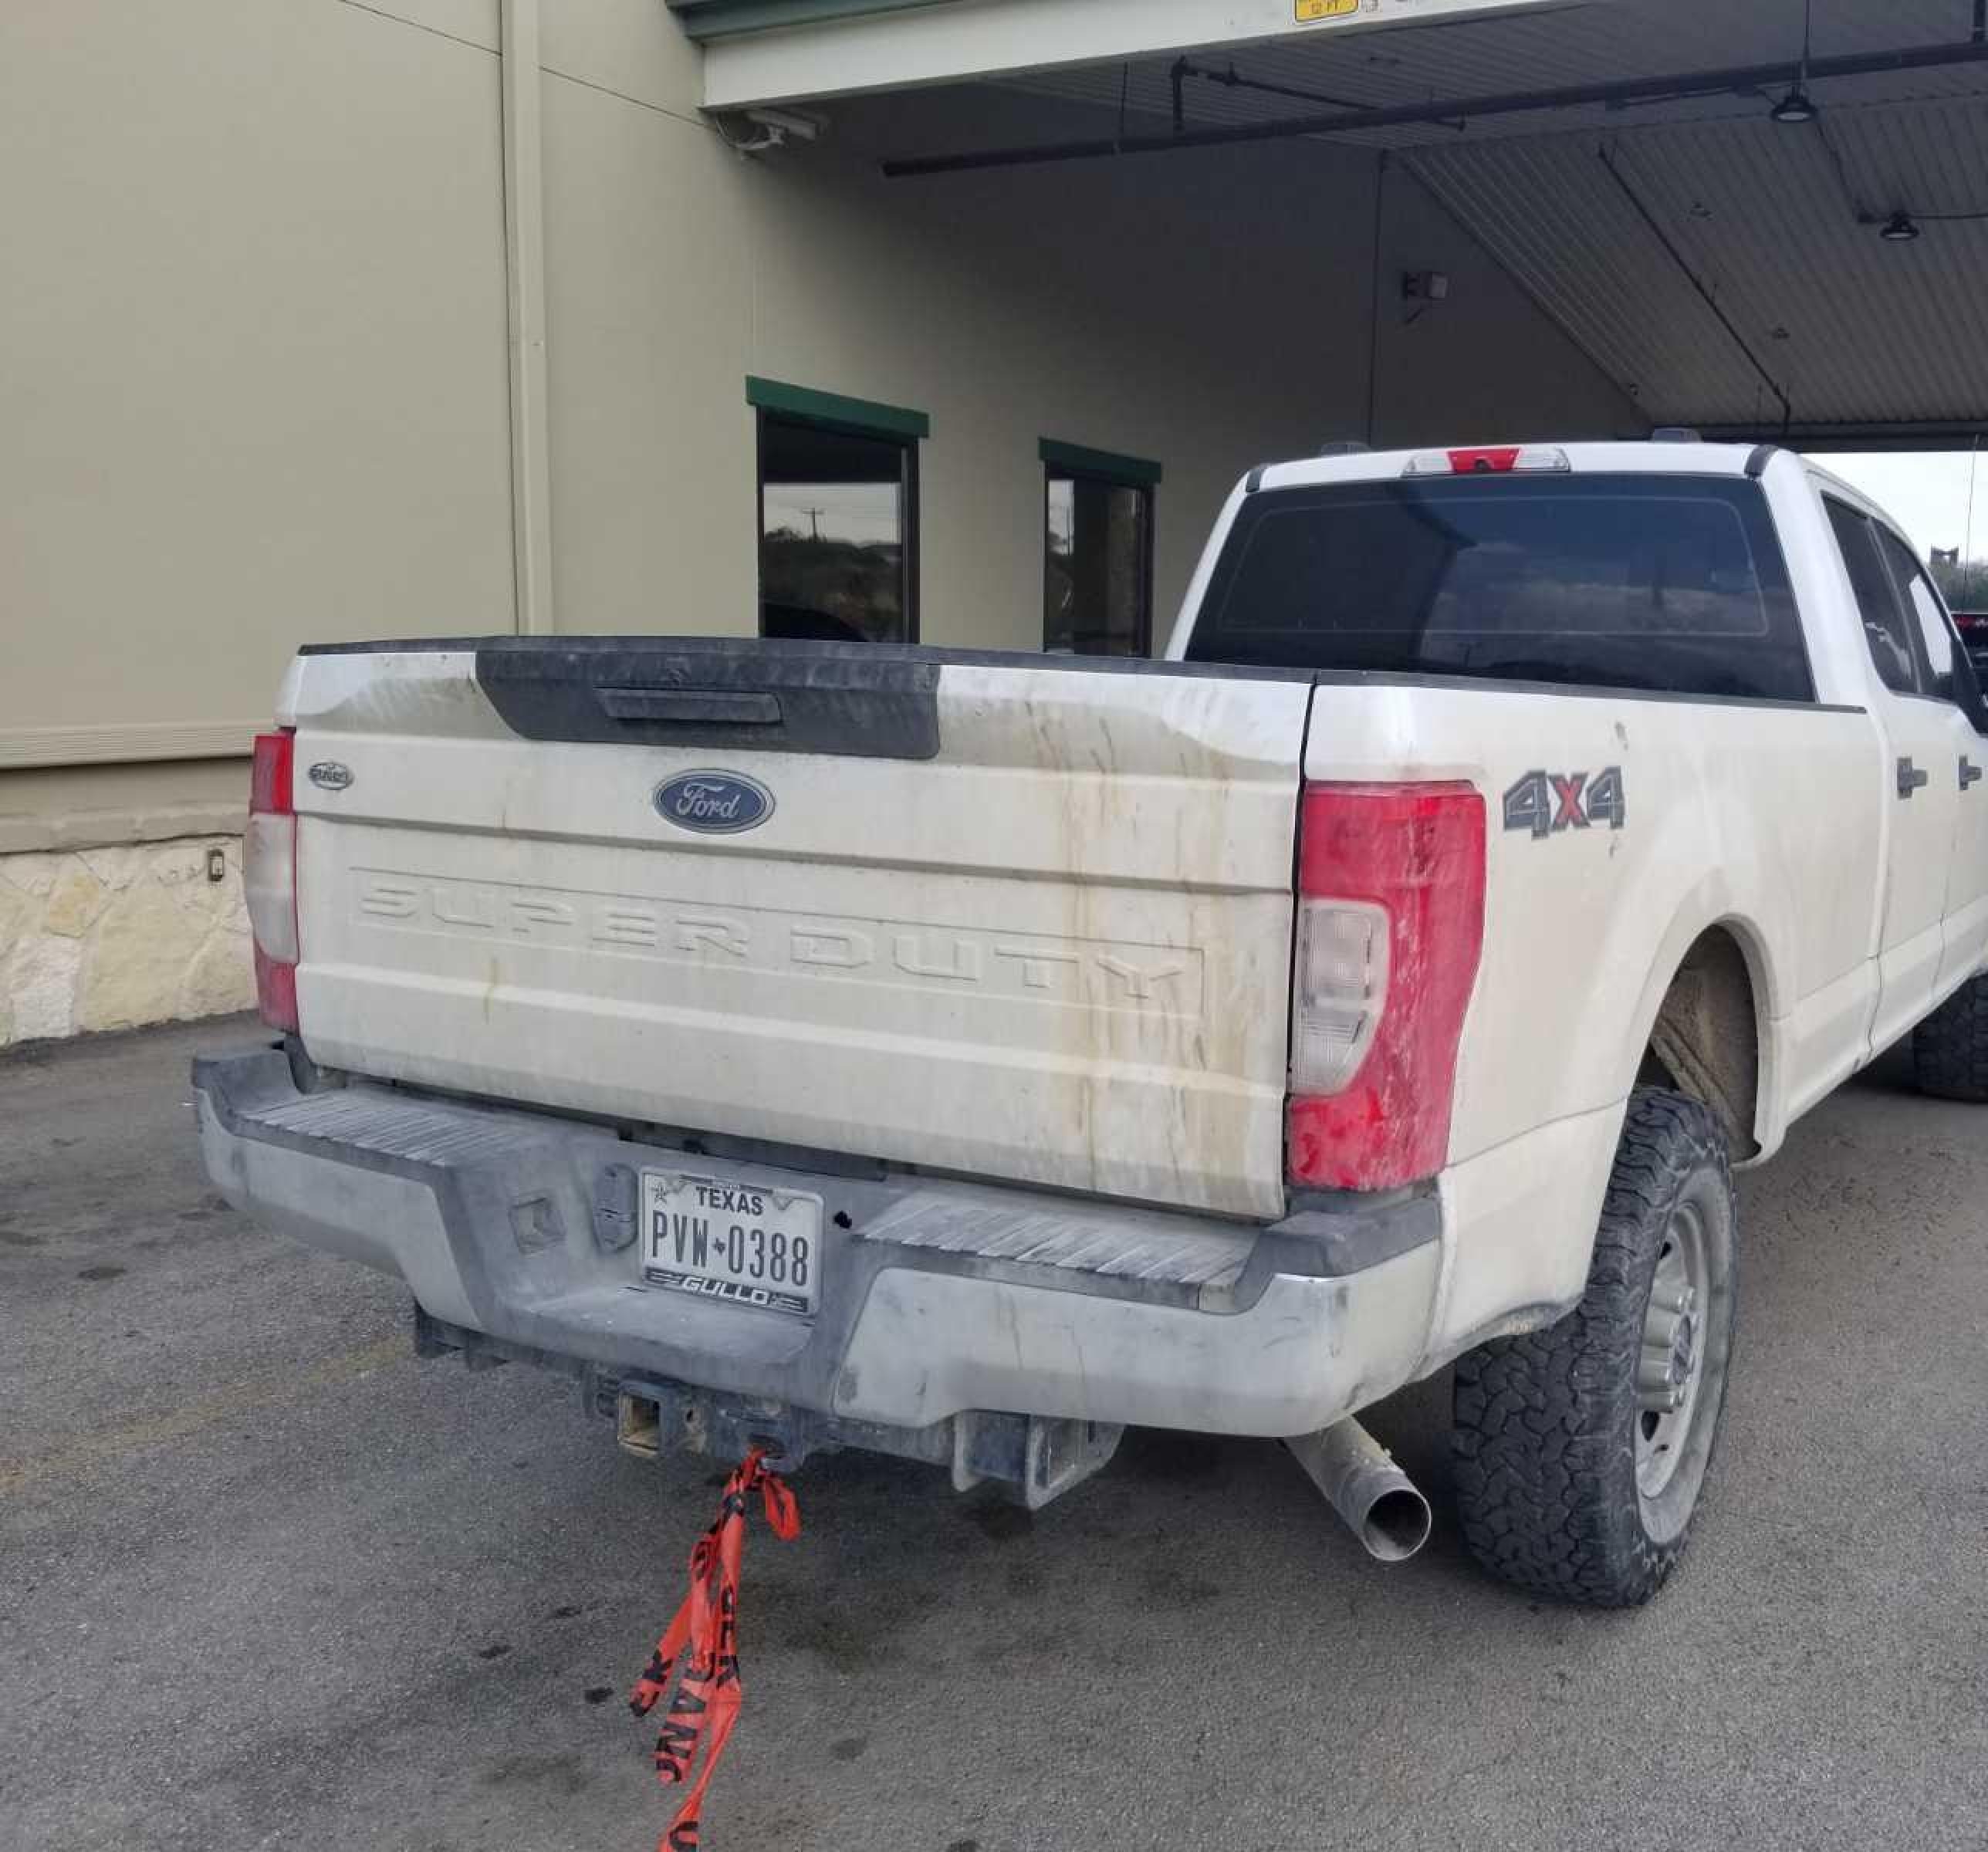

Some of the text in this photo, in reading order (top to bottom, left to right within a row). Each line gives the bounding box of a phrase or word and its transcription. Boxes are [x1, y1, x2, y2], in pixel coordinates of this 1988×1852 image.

[678, 782, 741, 818] Ford
[360, 881, 1185, 999] SUPER DUTY
[696, 1186, 762, 1216] TEXAS
[682, 1277, 770, 1305] GULLO
